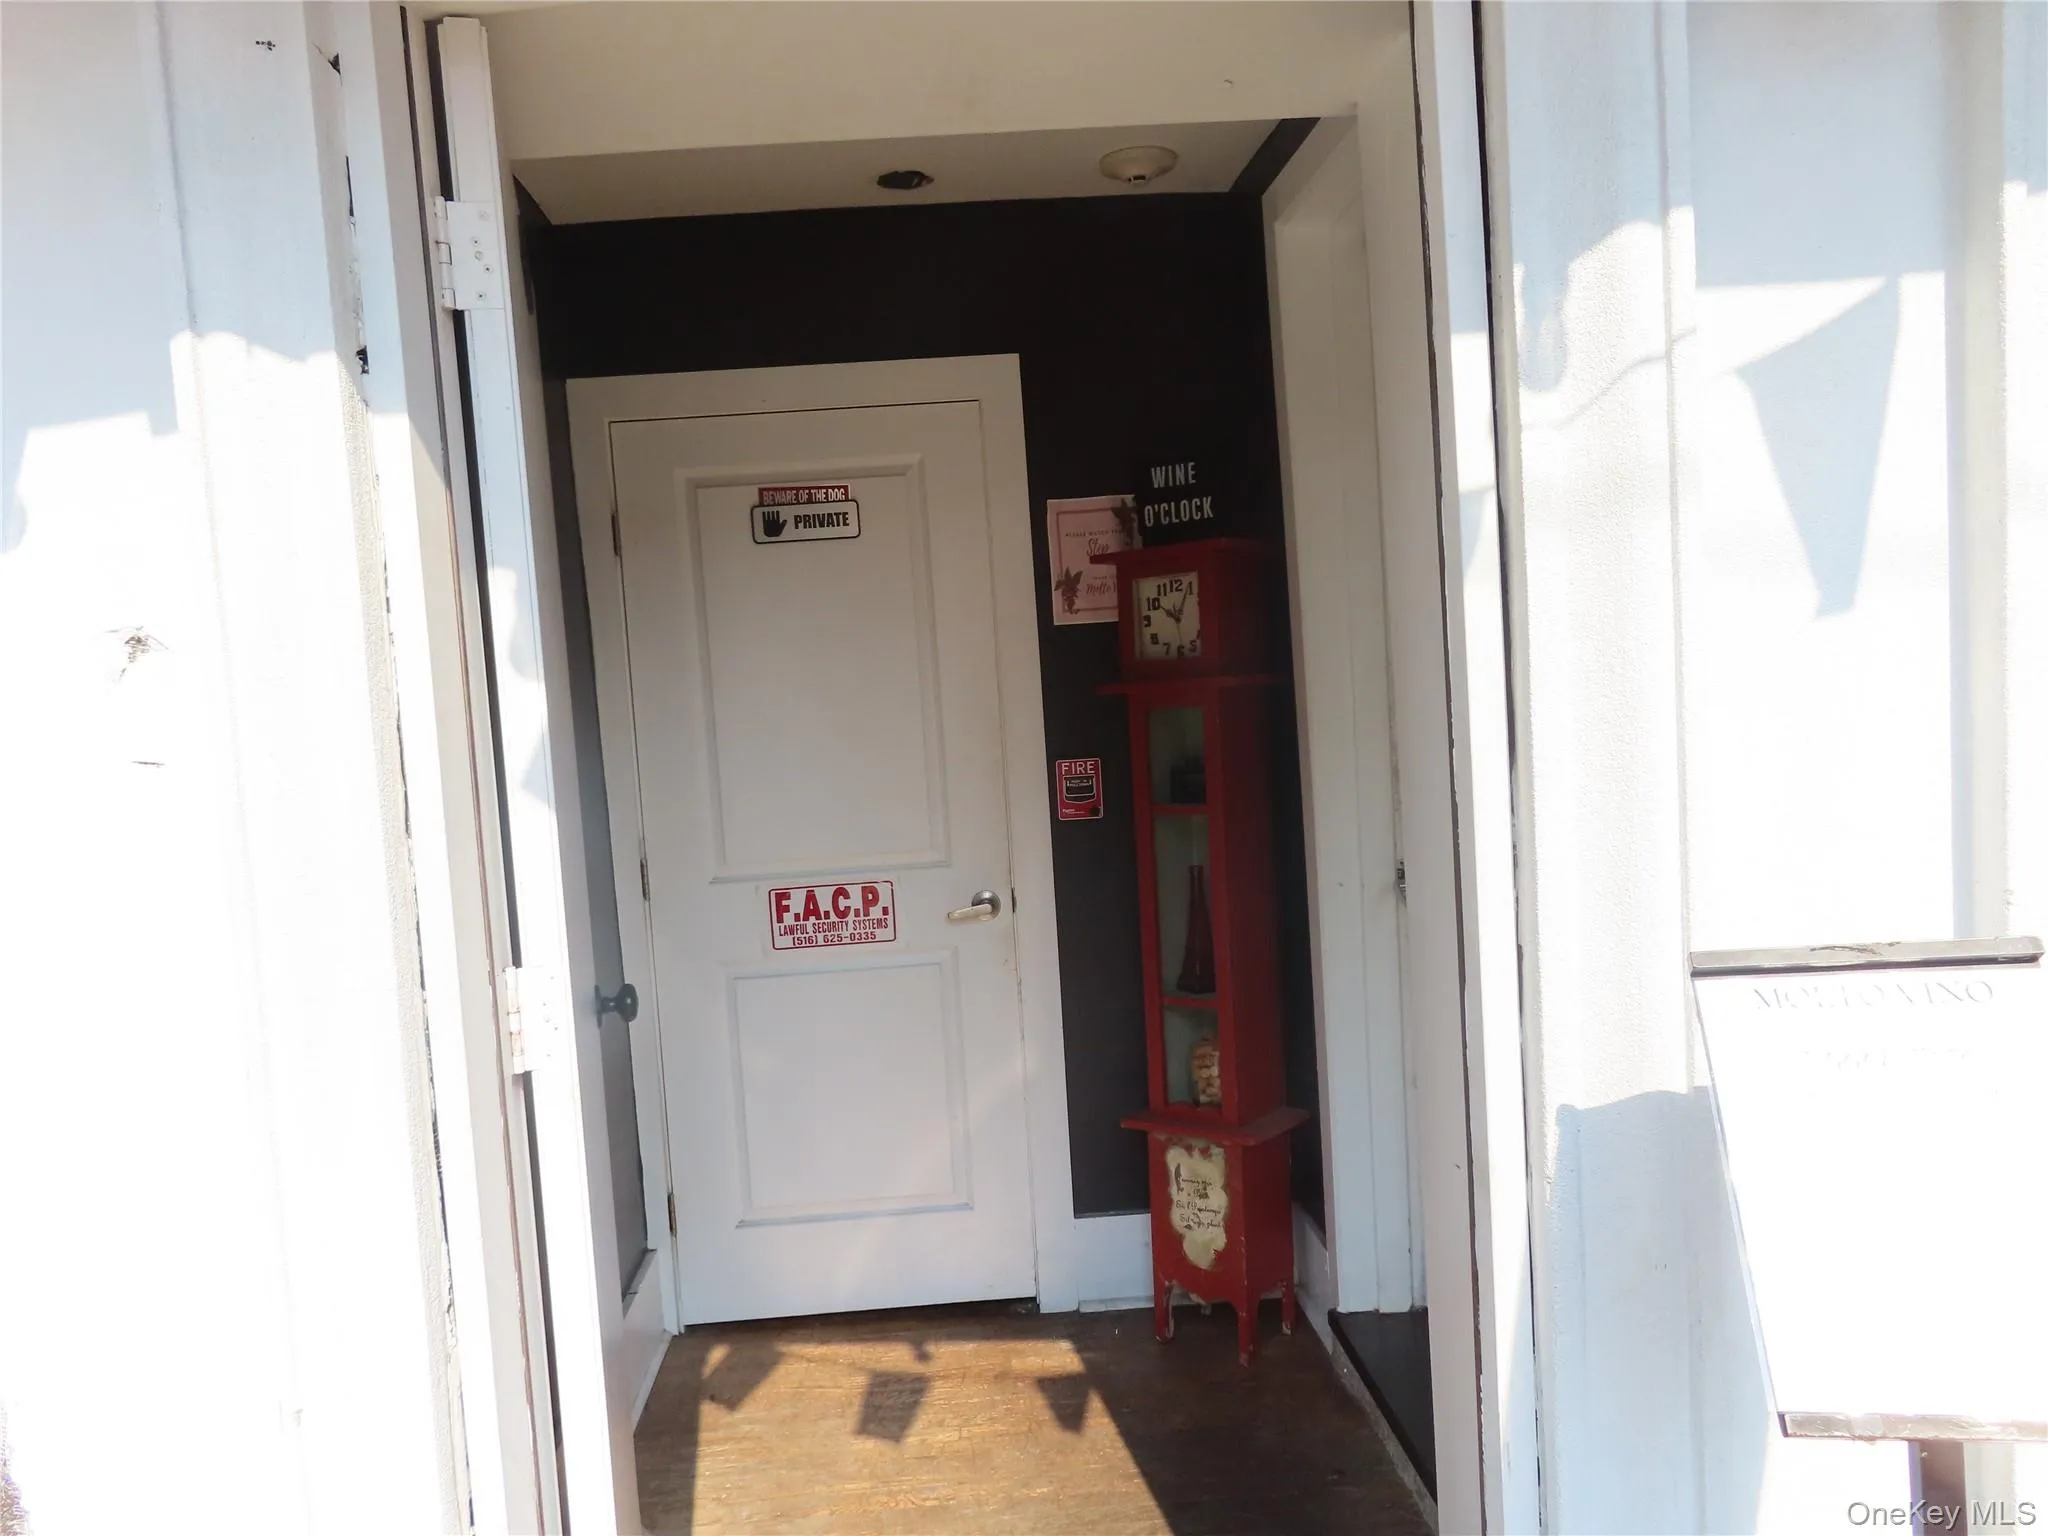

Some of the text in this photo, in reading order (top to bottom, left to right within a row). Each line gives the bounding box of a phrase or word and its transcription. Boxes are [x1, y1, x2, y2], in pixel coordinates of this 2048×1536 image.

[1151, 462, 1196, 488] WINE
[762, 488, 846, 505] BEWARE OF THE DOG
[1144, 496, 1214, 527] O'CLOCK
[793, 512, 850, 529] PRIVATE
[1156, 582, 1168, 596] 11
[1168, 579, 1183, 592] 12
[1187, 581, 1194, 595] 1
[1145, 596, 1160, 611] 10
[1143, 614, 1151, 627] 9
[1163, 642, 1171, 656] 7
[1061, 761, 1095, 775] FIRE
[774, 885, 890, 924] F.A.C.P.
[778, 917, 889, 937] LAWFUL SECURITY SYSTEMS
[823, 931, 877, 944] 625-0335
